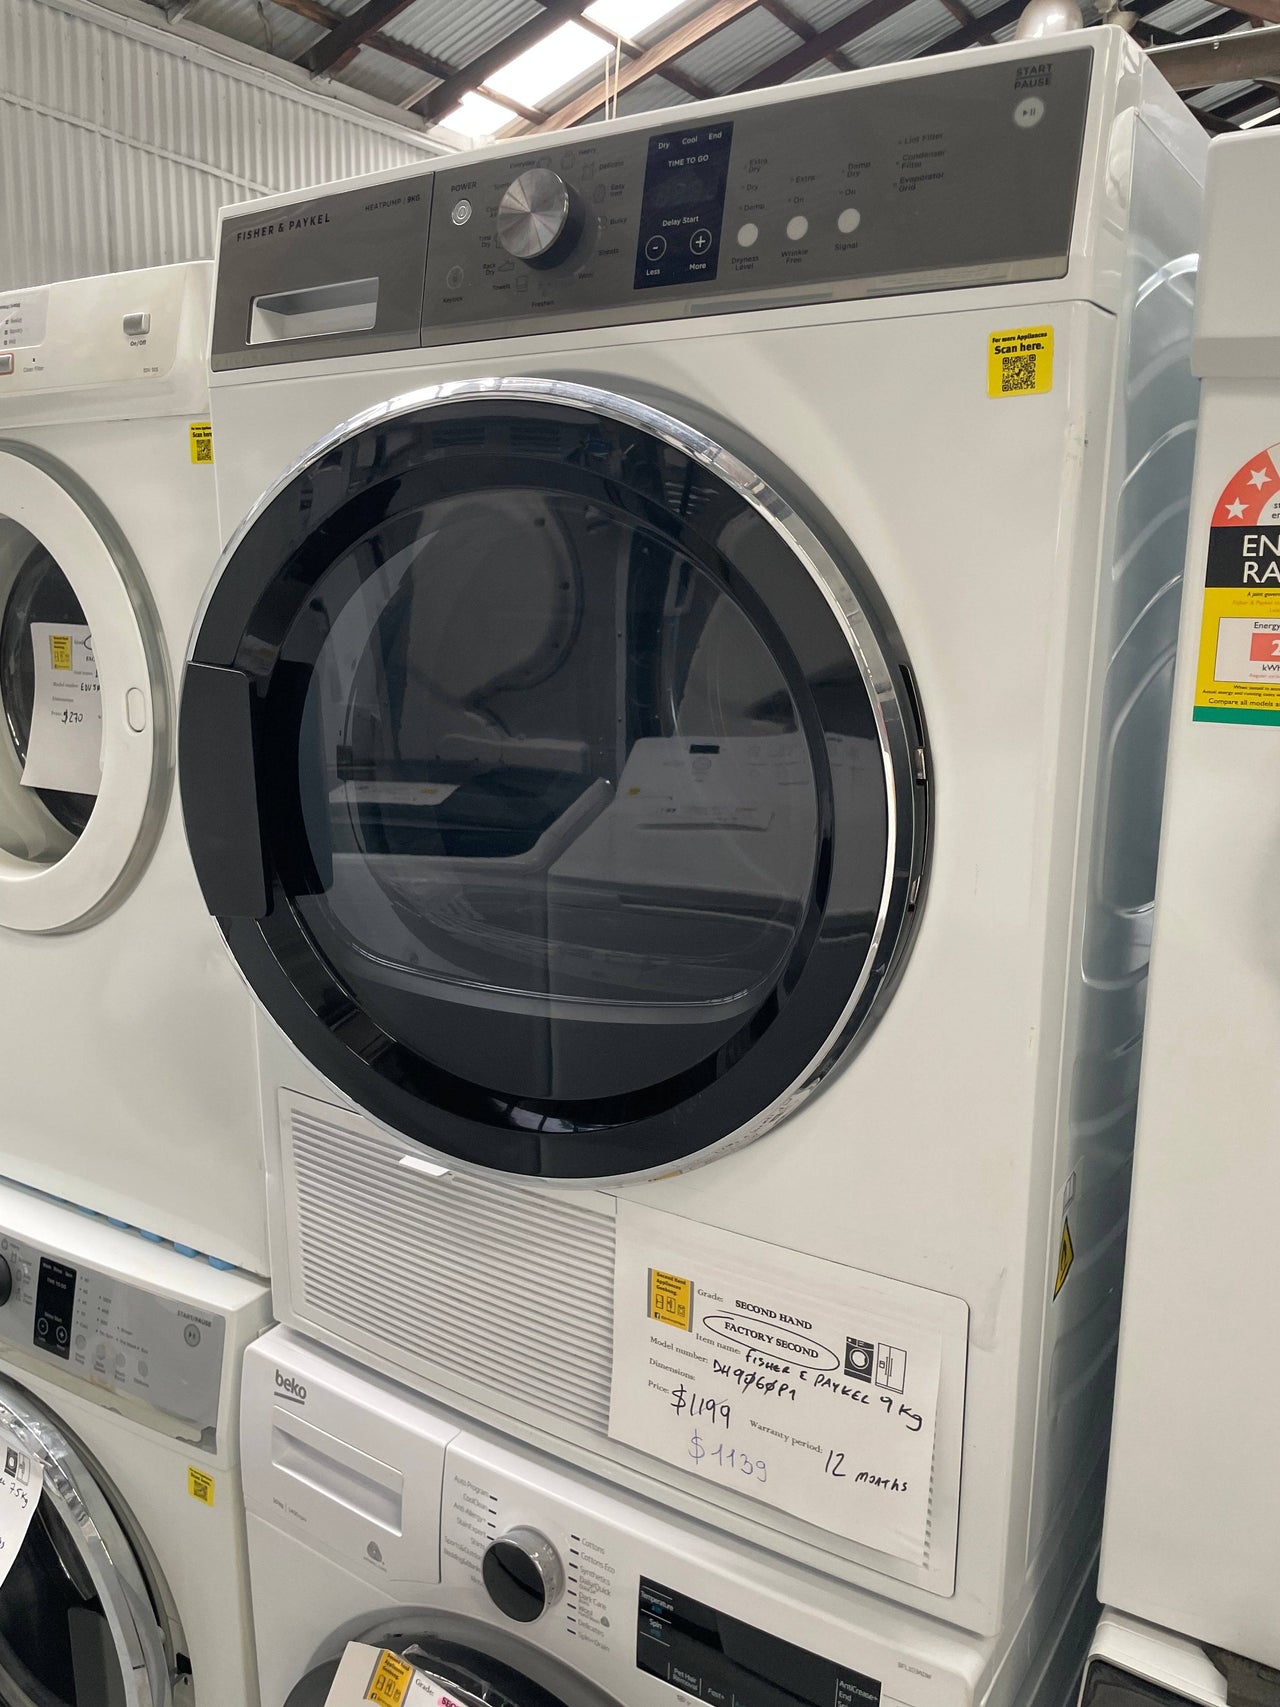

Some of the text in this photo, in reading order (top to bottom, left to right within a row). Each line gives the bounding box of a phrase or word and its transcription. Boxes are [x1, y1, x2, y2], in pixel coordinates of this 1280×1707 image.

[1015, 62, 1054, 78] START
[1013, 76, 1052, 90] PAUSE
[658, 132, 722, 150] Dry Cool End
[668, 154, 709, 168] TIME TO GO
[795, 174, 815, 184] Extra
[451, 181, 477, 192] POWER
[746, 183, 759, 192] Dry
[844, 187, 856, 196] On
[364, 194, 421, 211] HEATPUMP 9KG
[793, 195, 805, 205] On
[236, 213, 331, 242] FISHER & PAYKEL
[662, 215, 699, 228] Delay Start
[781, 248, 809, 258] Wrinkle
[834, 241, 858, 251] Signal
[689, 262, 707, 271] More
[731, 255, 759, 264] Dryness
[735, 262, 754, 271] Level
[646, 267, 661, 277] Less
[129, 339, 147, 347] On/Off
[1017, 332, 1047, 341] Appliances
[994, 342, 1044, 355] Scan here.
[1253, 621, 1280, 631] Energy
[1208, 697, 1239, 706] Compare
[61, 708, 84, 725] $270
[697, 1288, 724, 1302] Grade:
[735, 1298, 813, 1331] SECOND HAND
[724, 1321, 819, 1359] FACTORY SECOND
[649, 1335, 678, 1353] Model
[678, 1344, 709, 1365] number:
[648, 1357, 696, 1381] Dimensions:
[695, 1333, 715, 1345] Item
[716, 1341, 741, 1355] name:
[814, 1374, 870, 1405] PAYKEL
[879, 1396, 894, 1414] 9
[274, 1369, 307, 1400] beko
[647, 1379, 732, 1429] Price: $1199
[749, 1419, 823, 1454] Warranty period:
[687, 1428, 768, 1483] $1139
[825, 1449, 847, 1477] 12
[582, 1538, 605, 1555] Cottons
[580, 1551, 616, 1575] Cottons Eco
[580, 1565, 611, 1586] Synthetics
[640, 1590, 674, 1612] Temperature
[649, 1618, 663, 1630] Spin
[673, 1667, 684, 1679] Pet
[838, 1690, 852, 1702] End
